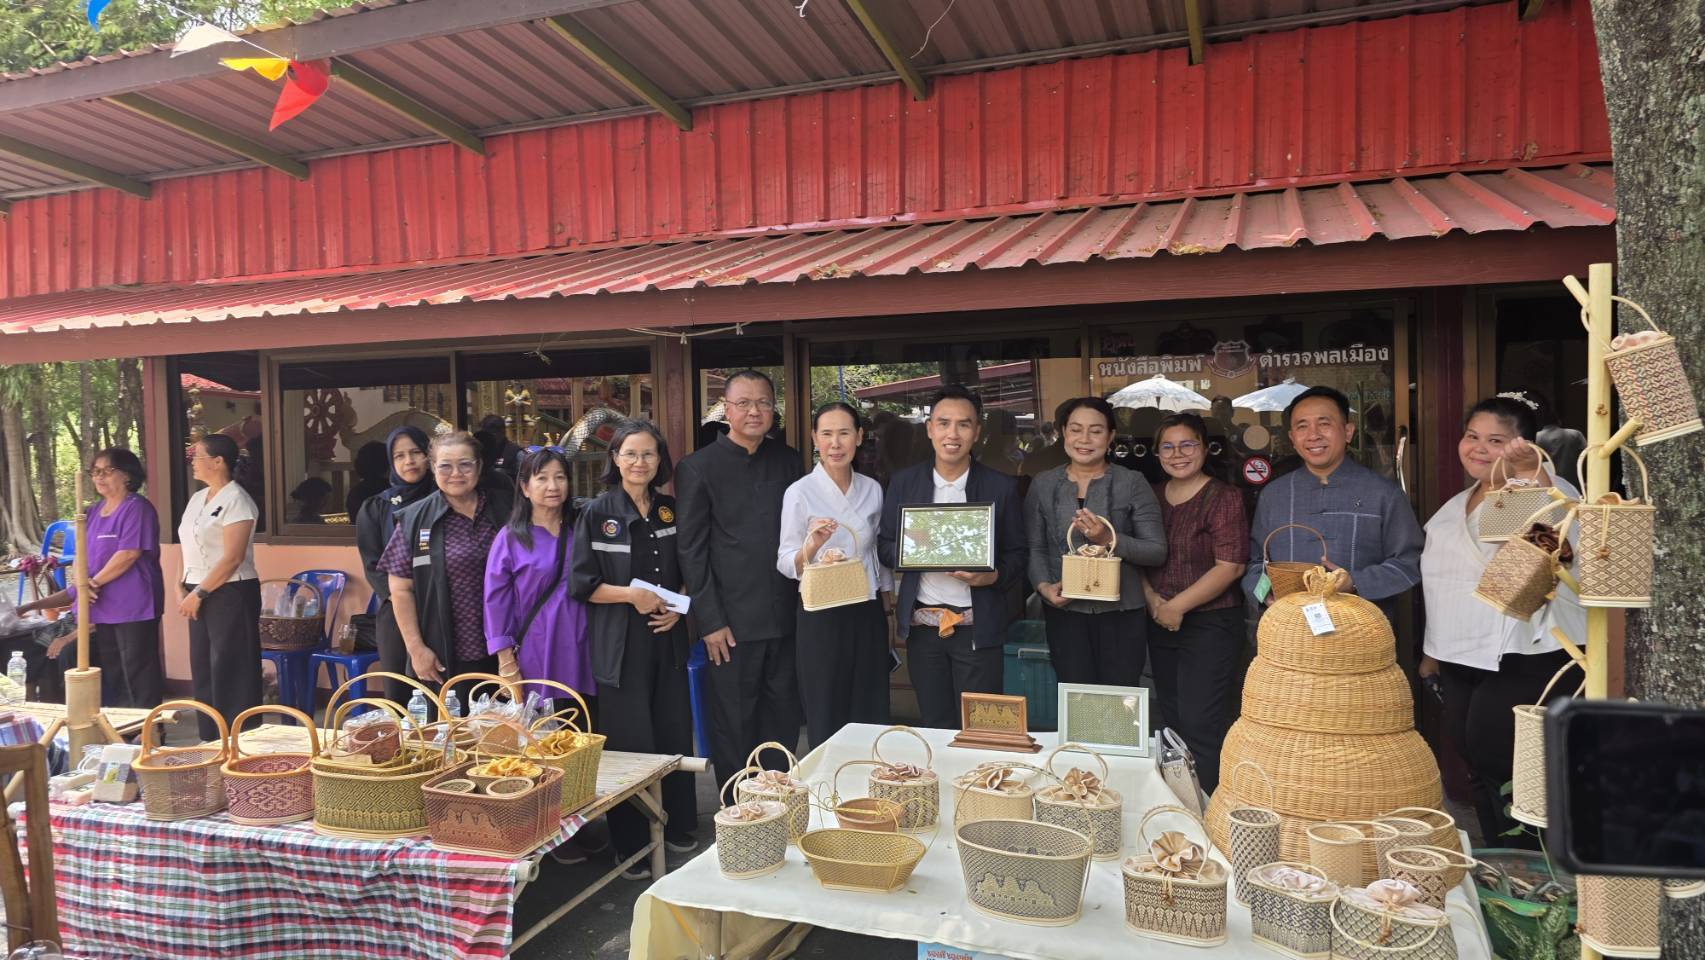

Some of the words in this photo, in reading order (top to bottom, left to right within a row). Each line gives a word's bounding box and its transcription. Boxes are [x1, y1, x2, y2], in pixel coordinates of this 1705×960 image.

[1100, 354, 1205, 376] หนังสือพิมพ์
[1259, 342, 1389, 368] ตำรวจพลเมือง
